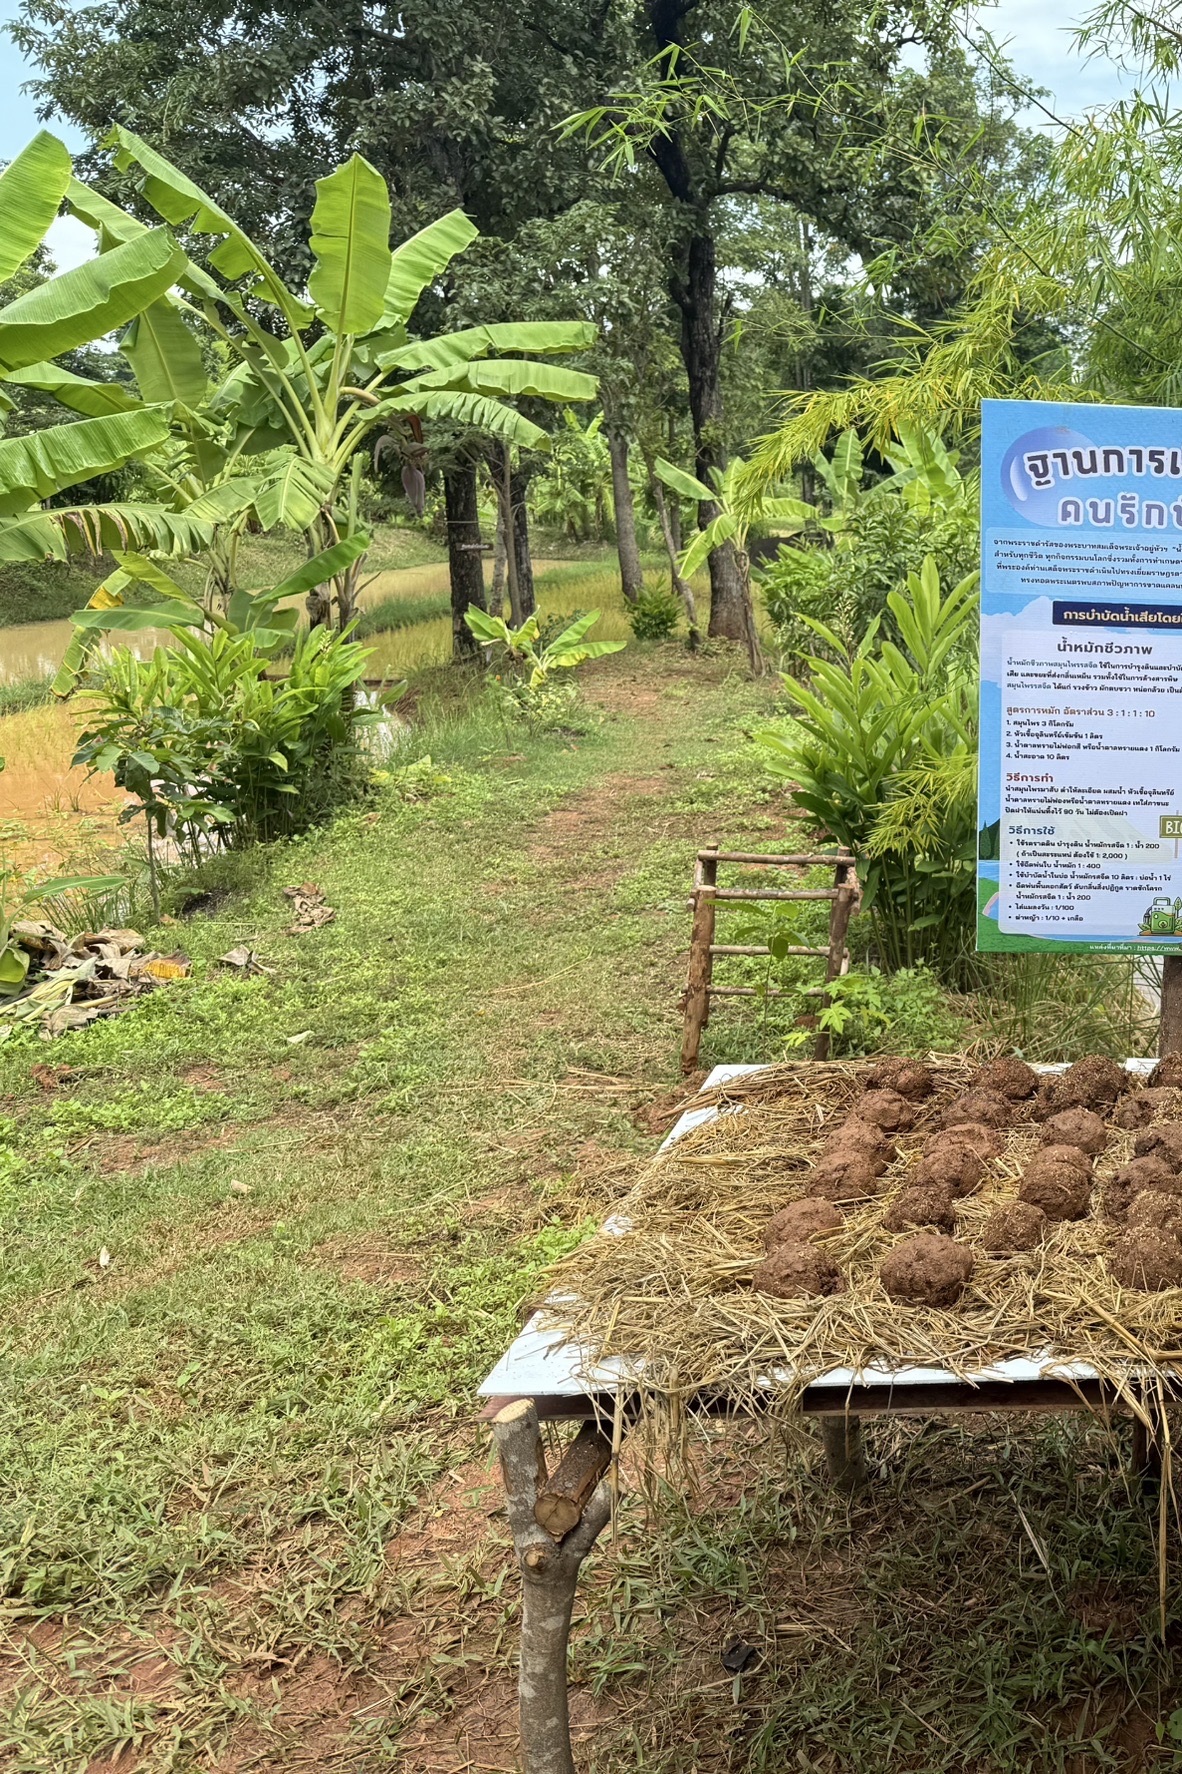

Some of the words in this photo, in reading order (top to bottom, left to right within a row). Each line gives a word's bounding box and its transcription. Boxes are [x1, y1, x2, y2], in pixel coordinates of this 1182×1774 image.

[1057, 636, 1153, 655] น้ำหมักชีวภาพ
[1006, 669, 1020, 677] เสีย
[1052, 681, 1072, 690] ได้แก่
[1006, 705, 1061, 716] สูตรการหมัก
[1063, 706, 1105, 716] อัตราส่วน
[1144, 709, 1155, 718] 10
[1089, 731, 1103, 740] ลิตร
[1056, 752, 1070, 761] ลิตร
[1006, 772, 1054, 783] วิธีการทำ
[1103, 785, 1126, 795] ผสมน้ำ
[1008, 824, 1056, 836] วิธีการใช้
[1134, 840, 1144, 849] น้ำ
[1145, 842, 1160, 850] 200
[1102, 852, 1124, 860] 2,000
[1120, 873, 1134, 881] ลิตร
[1139, 872, 1158, 881] บ่อน้ำ
[1065, 891, 1076, 900] น้ำ
[1067, 914, 1084, 922] เกลือ
